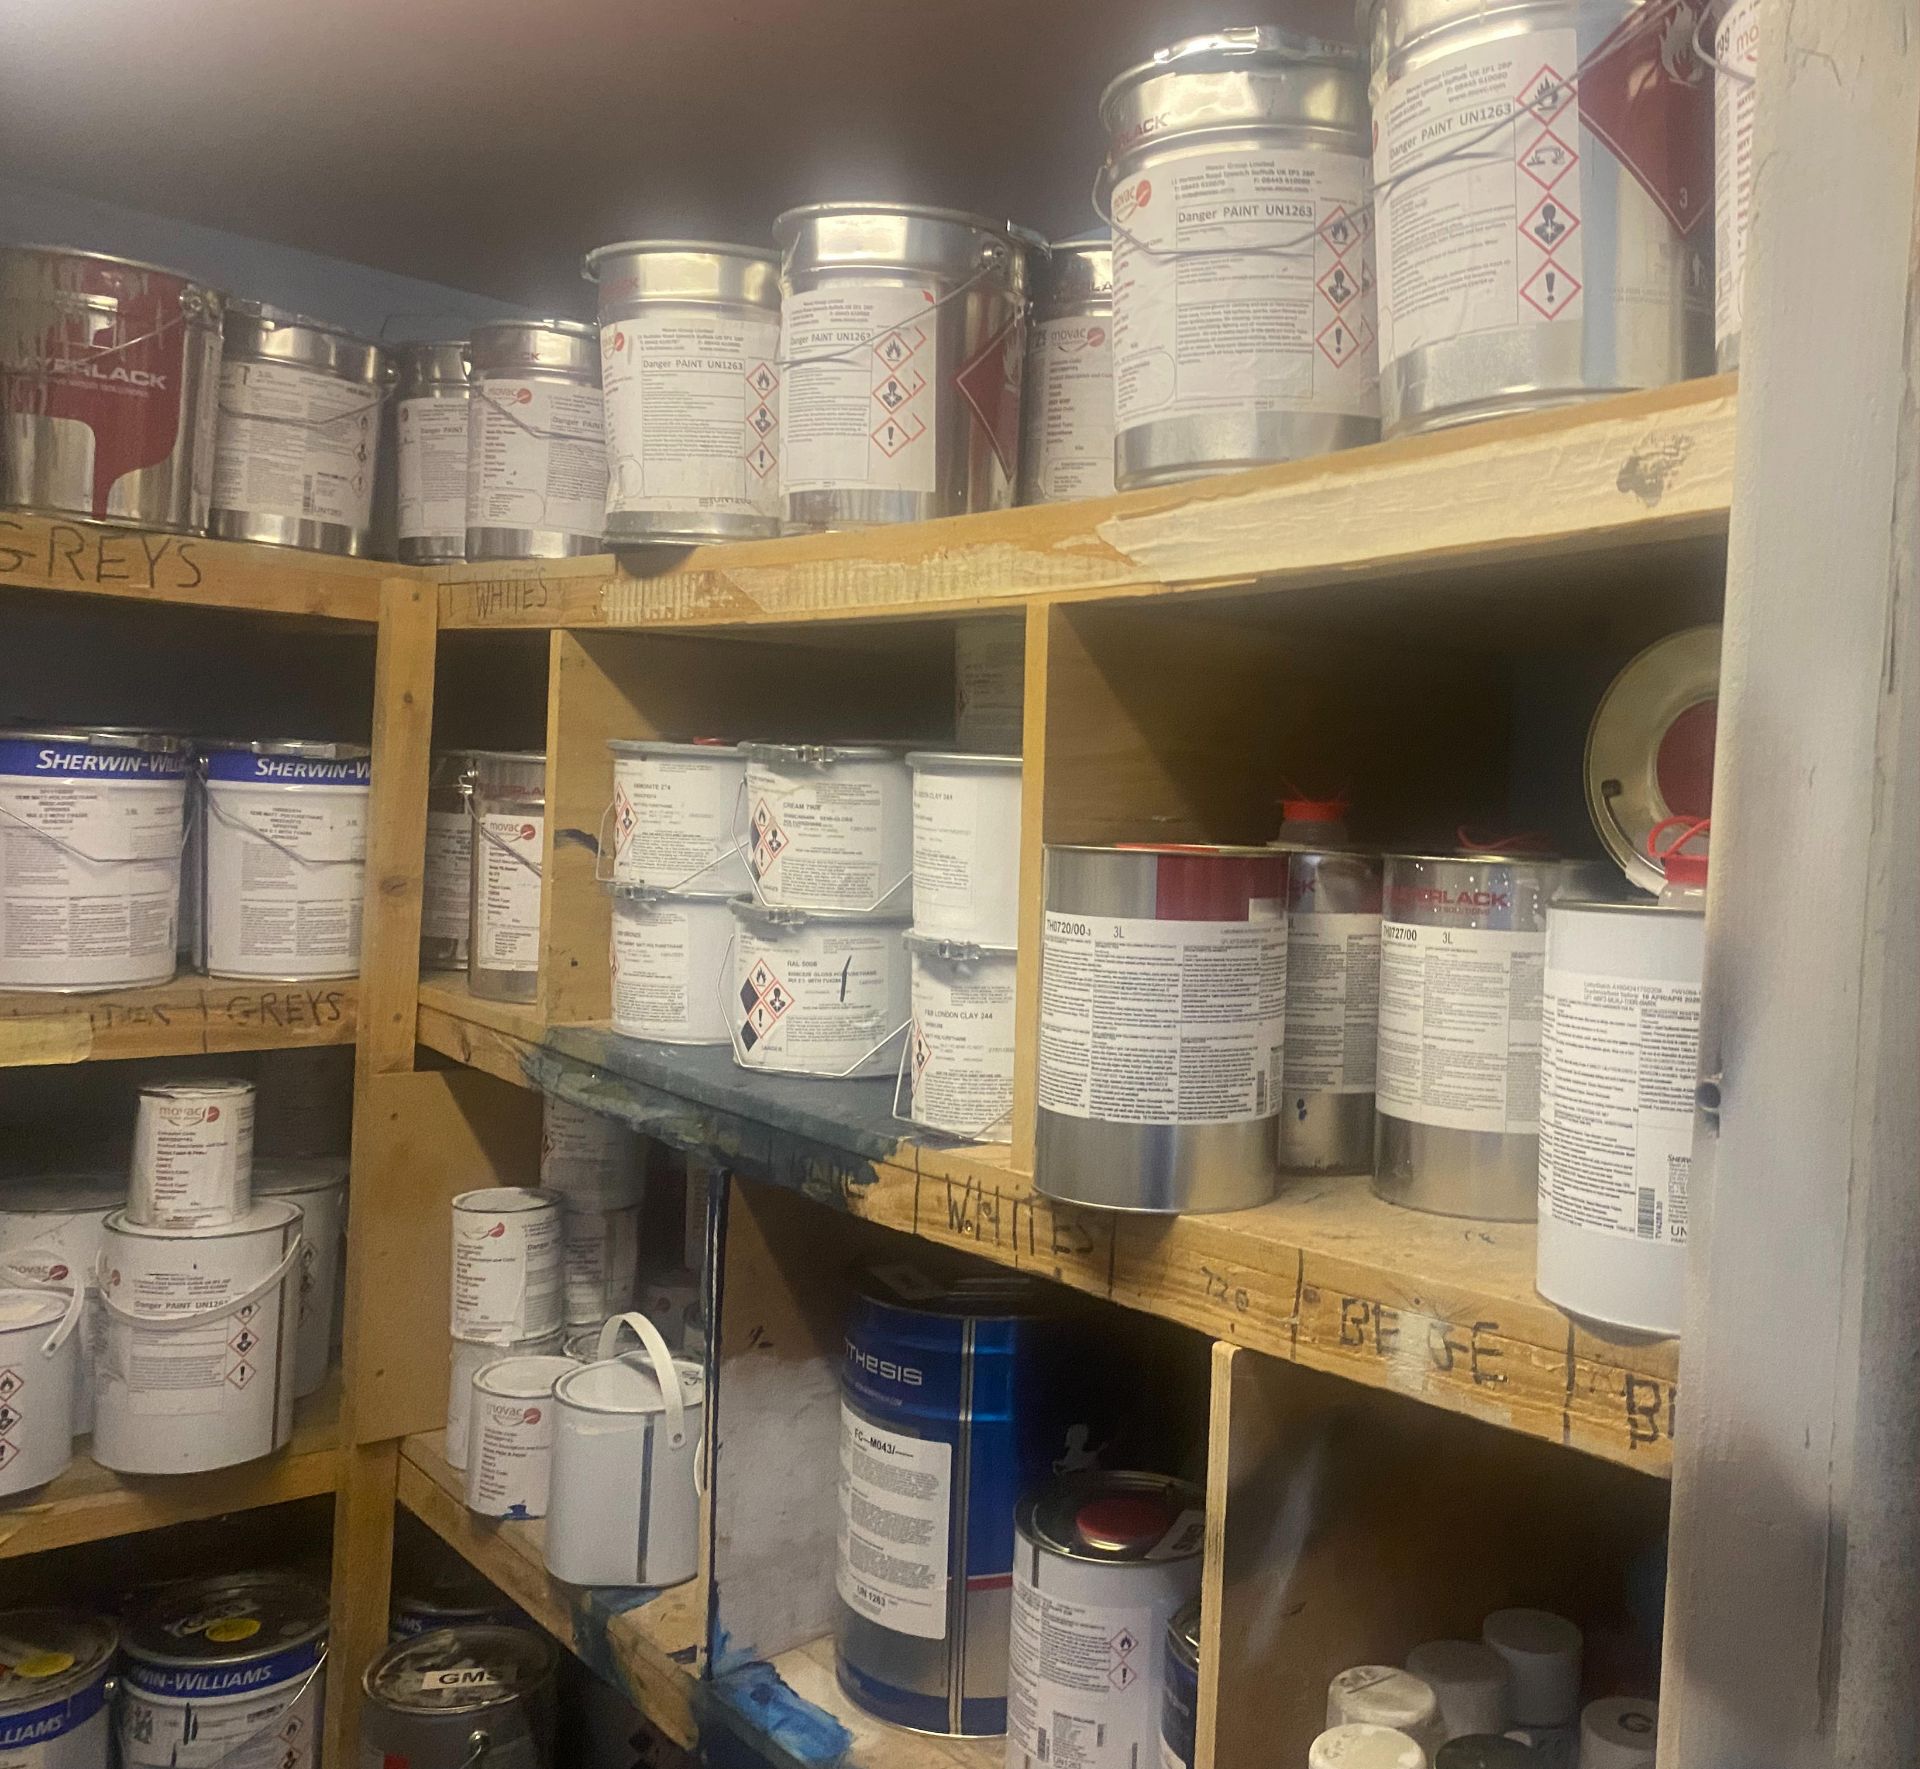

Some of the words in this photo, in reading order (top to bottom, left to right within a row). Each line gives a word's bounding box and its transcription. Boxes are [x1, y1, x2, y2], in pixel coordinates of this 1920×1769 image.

[1421, 118, 1453, 141] PAINT
[1460, 102, 1512, 126] UN1263
[1680, 187, 1688, 209] 3
[1178, 209, 1217, 223] Danger
[1223, 204, 1260, 218] PAINT
[1265, 205, 1313, 217] UN1263
[811, 333, 833, 342] PAINT
[643, 360, 671, 369] Danger
[676, 360, 702, 368] PAINT
[708, 361, 743, 370] UN1263
[475, 565, 548, 619] WHITES
[783, 802, 805, 810] CREAM
[489, 822, 520, 833] movac
[1113, 926, 1125, 939] 3L
[1442, 931, 1454, 945] 3L
[226, 991, 346, 1027] GREYS
[934, 1010, 959, 1019] LONDON
[960, 1012, 979, 1020] CLAY
[945, 1174, 1094, 1256] WHITES
[1340, 1297, 1509, 1385] BEGE
[0, 1716, 64, 1743] LIAMS
